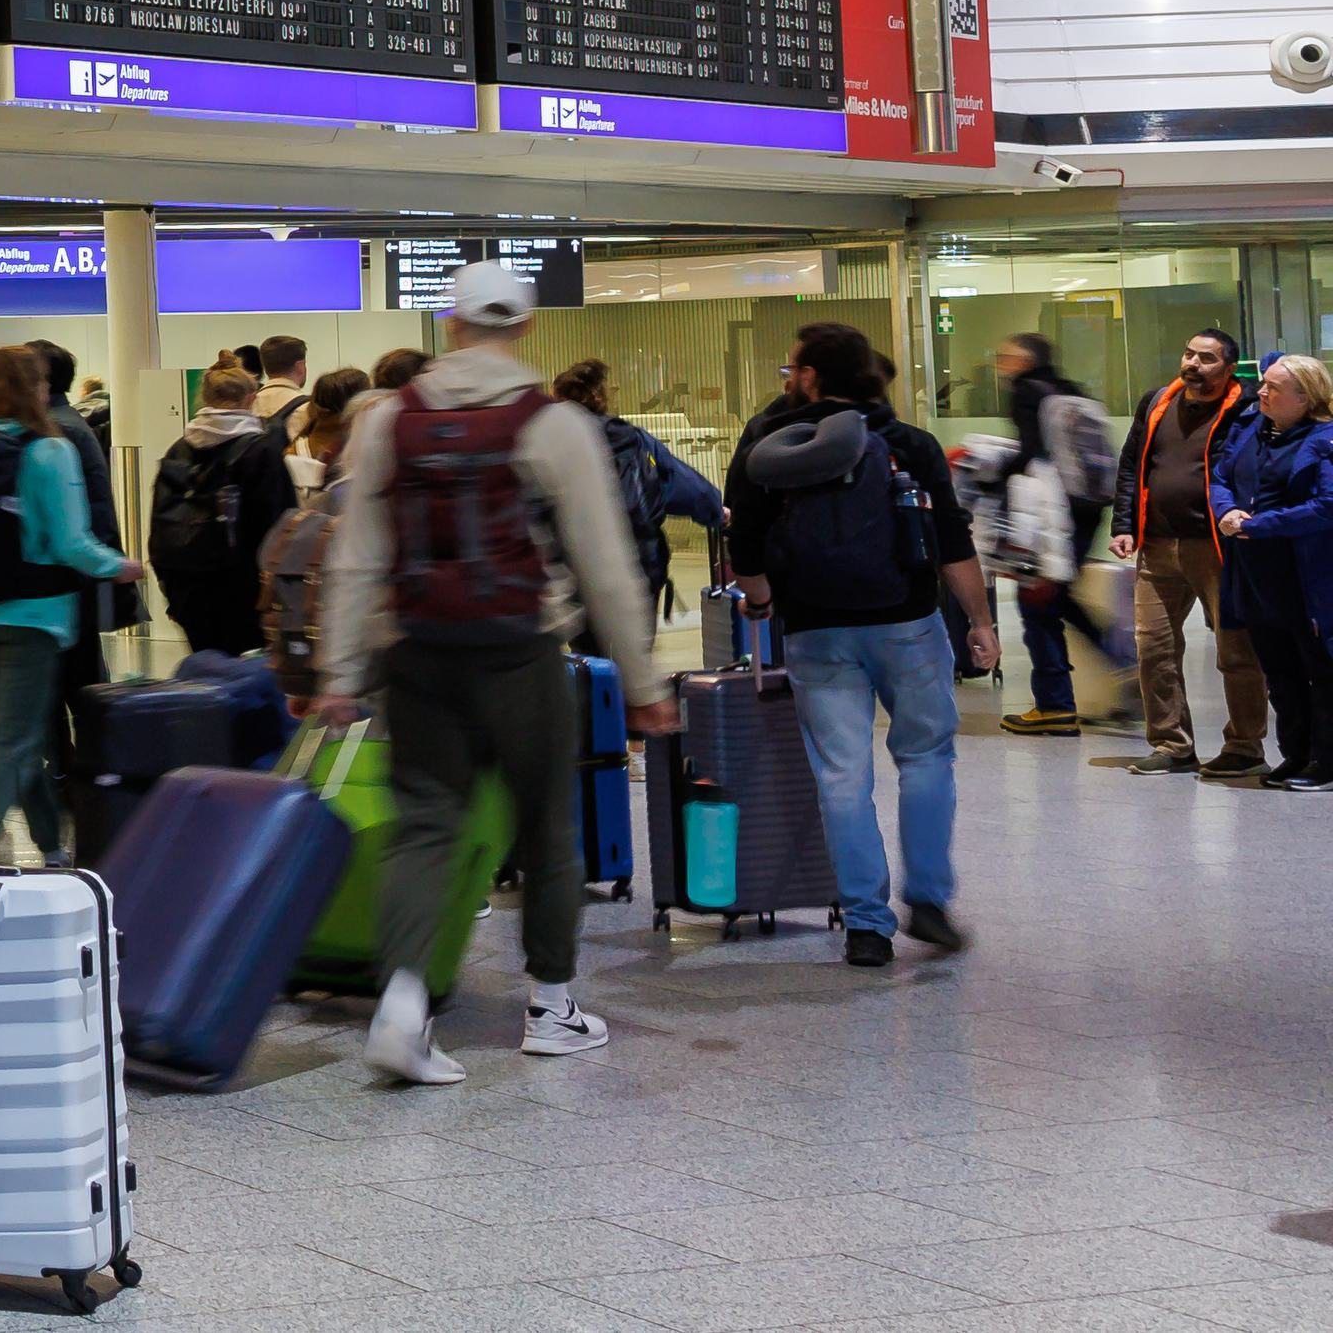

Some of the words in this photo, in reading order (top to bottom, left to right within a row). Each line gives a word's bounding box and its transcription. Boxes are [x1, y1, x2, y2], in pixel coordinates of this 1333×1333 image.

[130, 11, 239, 35] WROCLAW/BRESLAU
[583, 14, 616, 29] ZAGREB
[120, 64, 150, 83] Abflug
[121, 83, 168, 102] Departures
[871, 98, 880, 117] &
[880, 100, 908, 119] More
[0, 261, 50, 274] Departures
